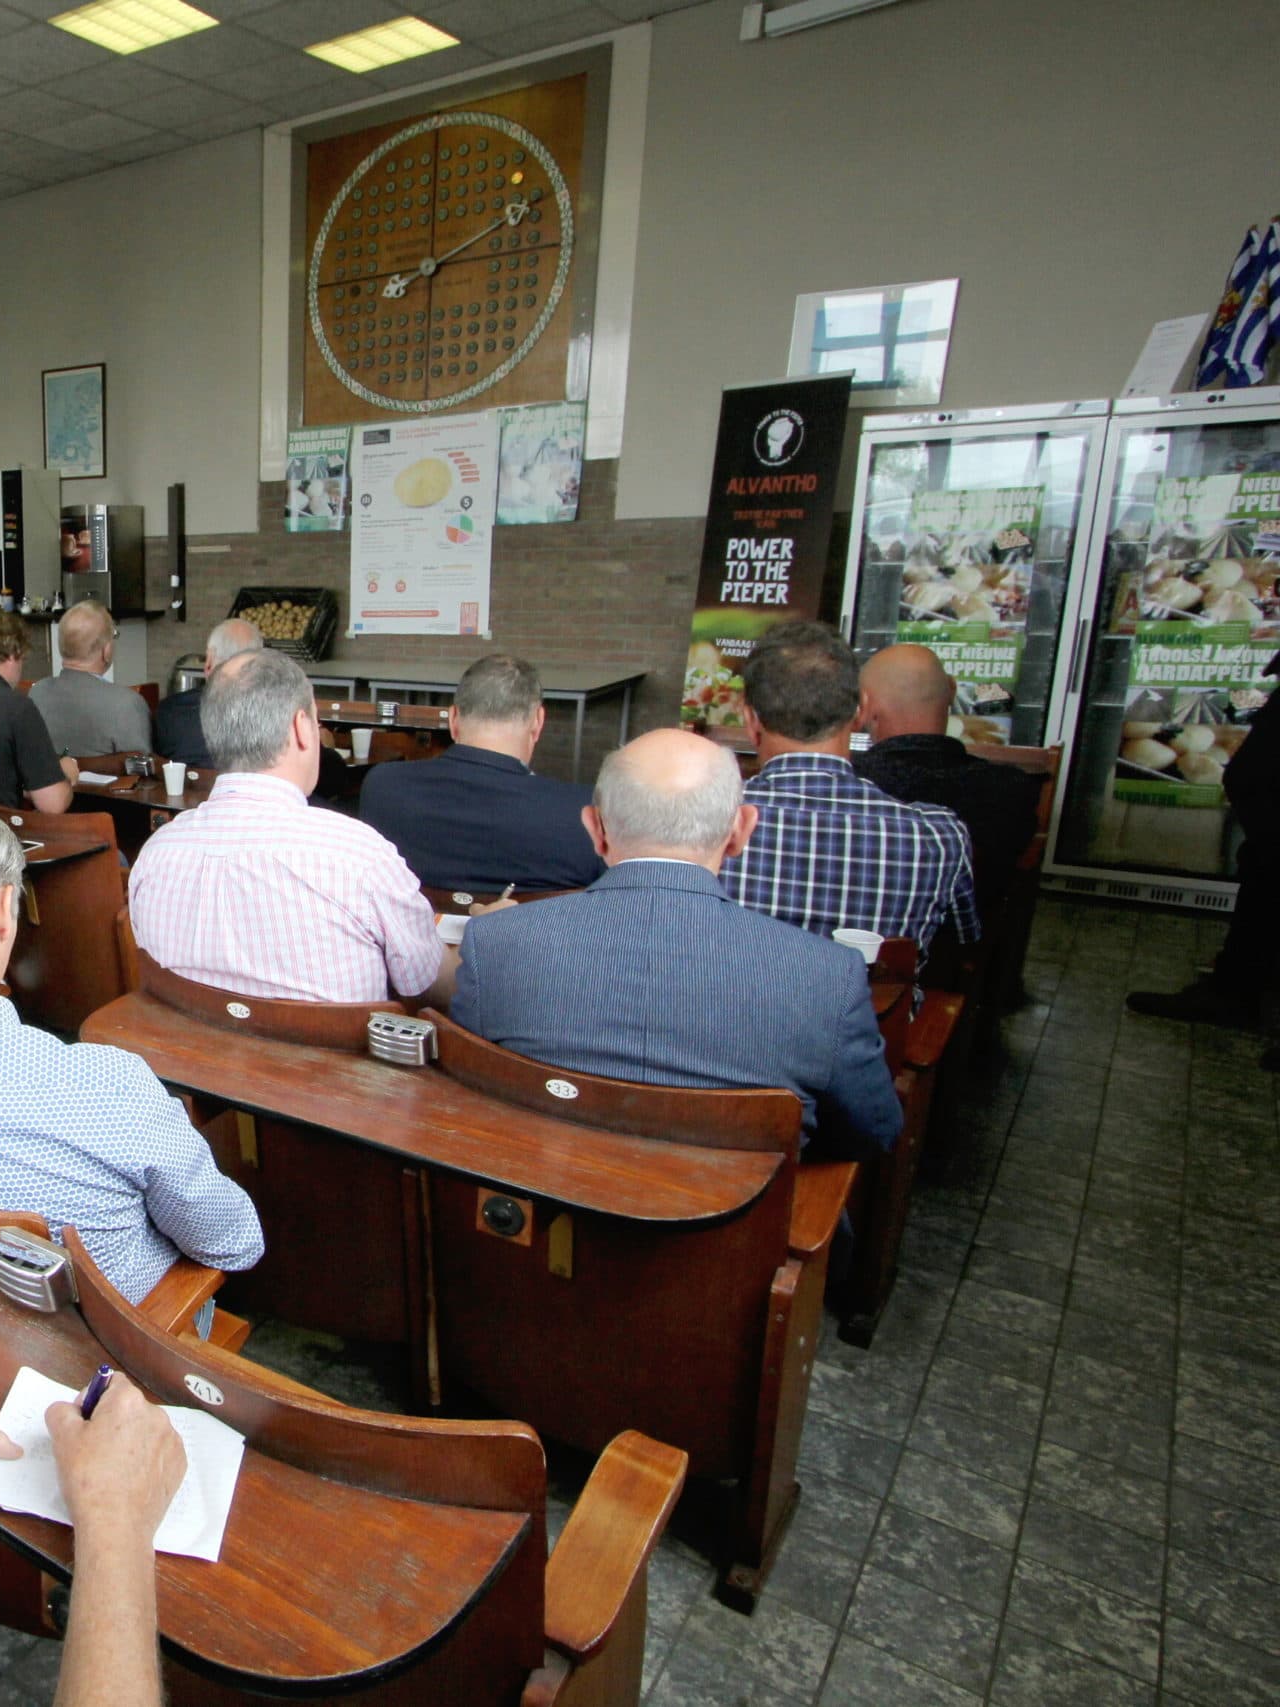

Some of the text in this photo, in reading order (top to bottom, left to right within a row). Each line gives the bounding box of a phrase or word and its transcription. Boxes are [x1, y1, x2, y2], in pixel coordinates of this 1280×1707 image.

[726, 474, 817, 495] ALVANTHO
[1241, 477, 1280, 493] NIEU
[1229, 494, 1280, 514] PPEL
[726, 538, 793, 559] POWER
[725, 561, 791, 580] TO THE
[720, 582, 788, 604] PIEPER
[961, 647, 1017, 660] NIEUWE
[944, 661, 1014, 678] APPELEN
[231, 1004, 245, 1016] 34
[552, 1081, 570, 1097] 33
[193, 1381, 212, 1401] 41
